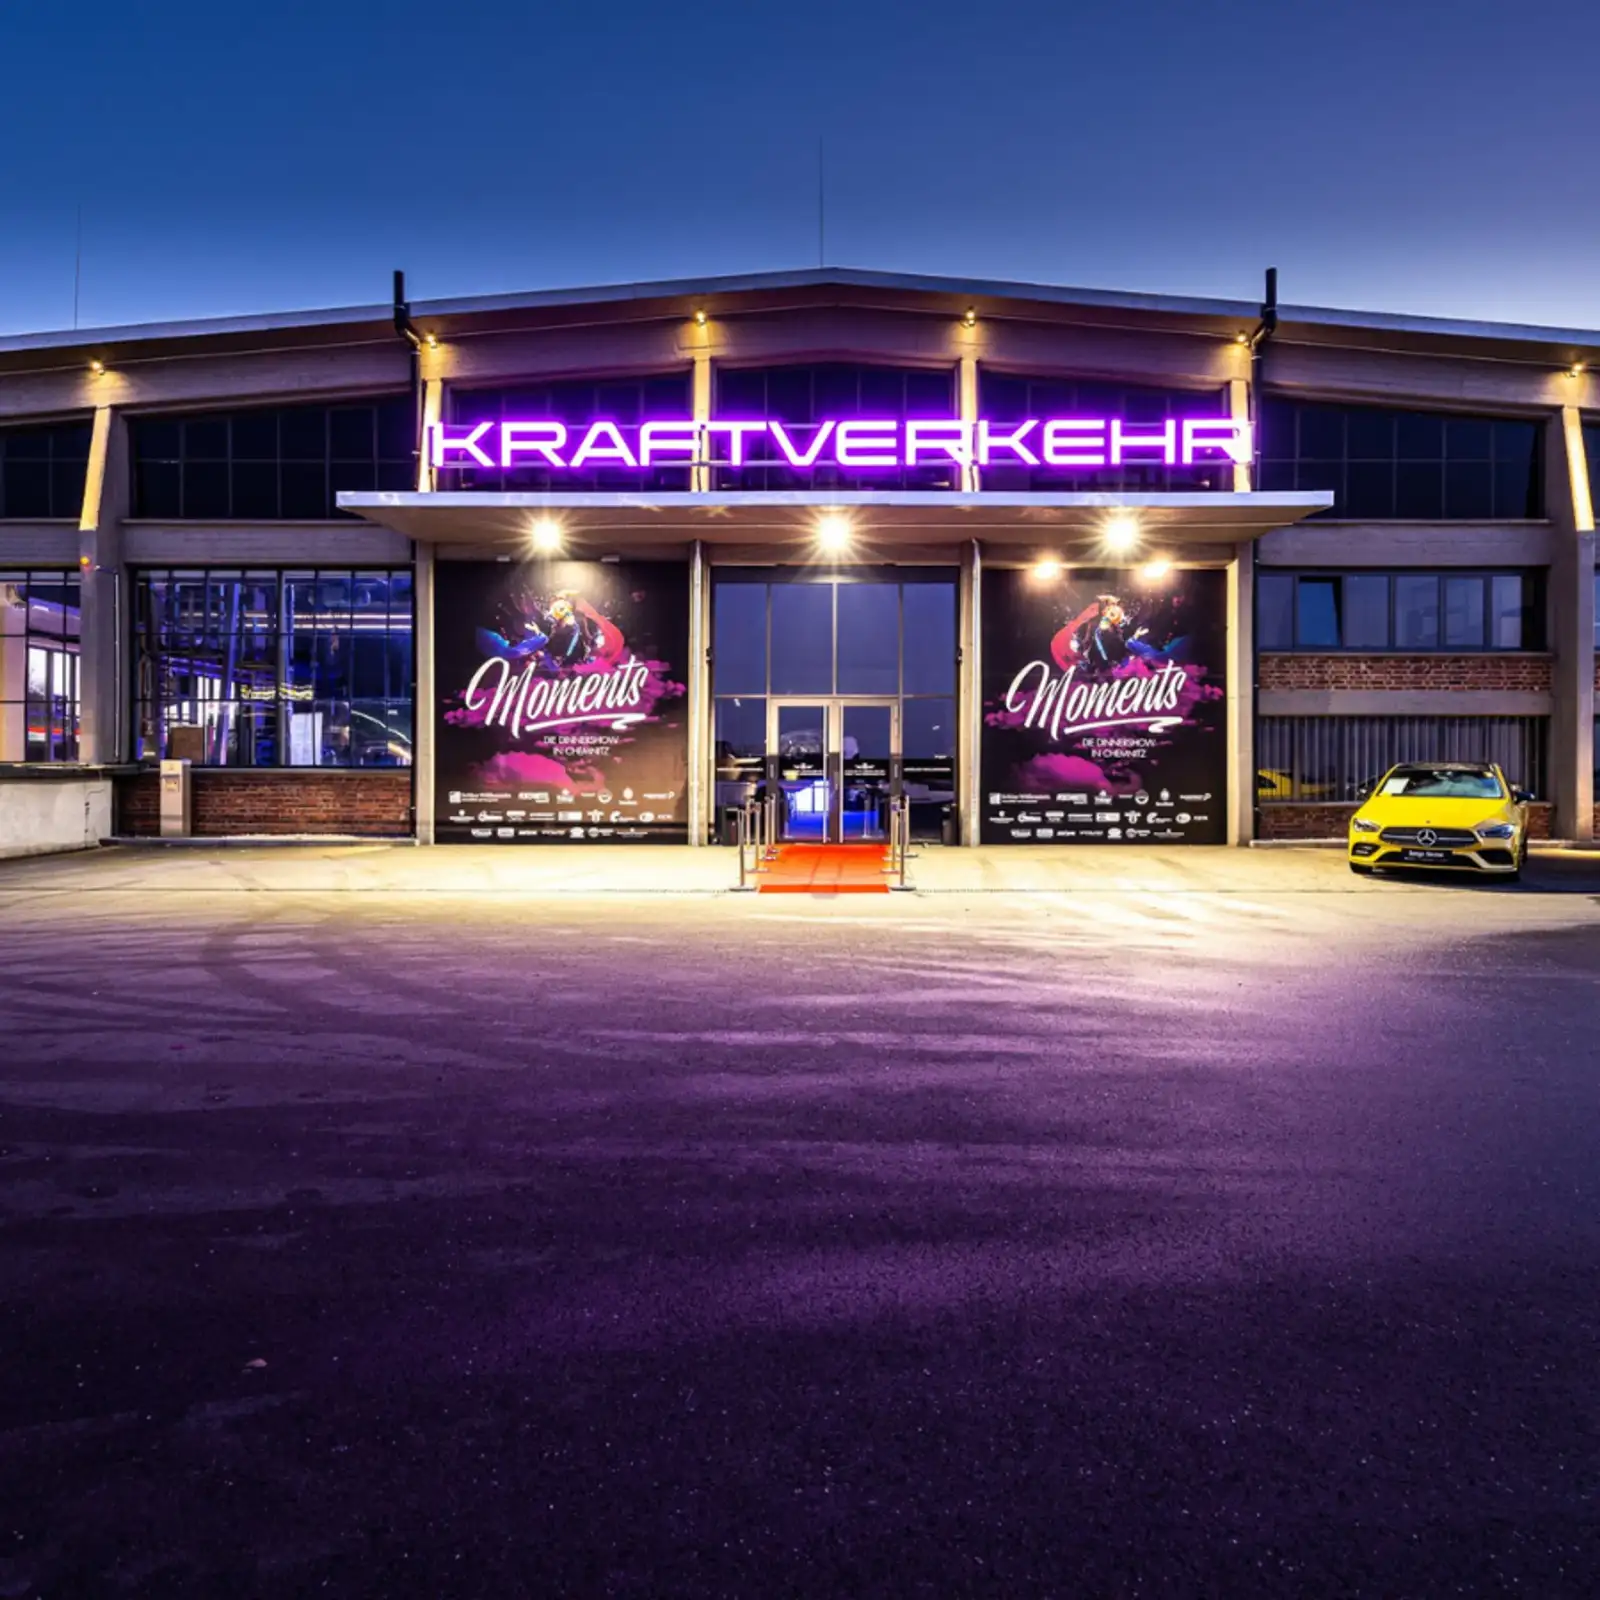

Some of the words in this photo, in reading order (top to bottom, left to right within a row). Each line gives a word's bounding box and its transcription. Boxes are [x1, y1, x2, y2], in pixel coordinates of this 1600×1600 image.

[430, 418, 1253, 468] KRAFTVERKEHR
[465, 653, 649, 738] Moments
[1005, 658, 1186, 741] Moments
